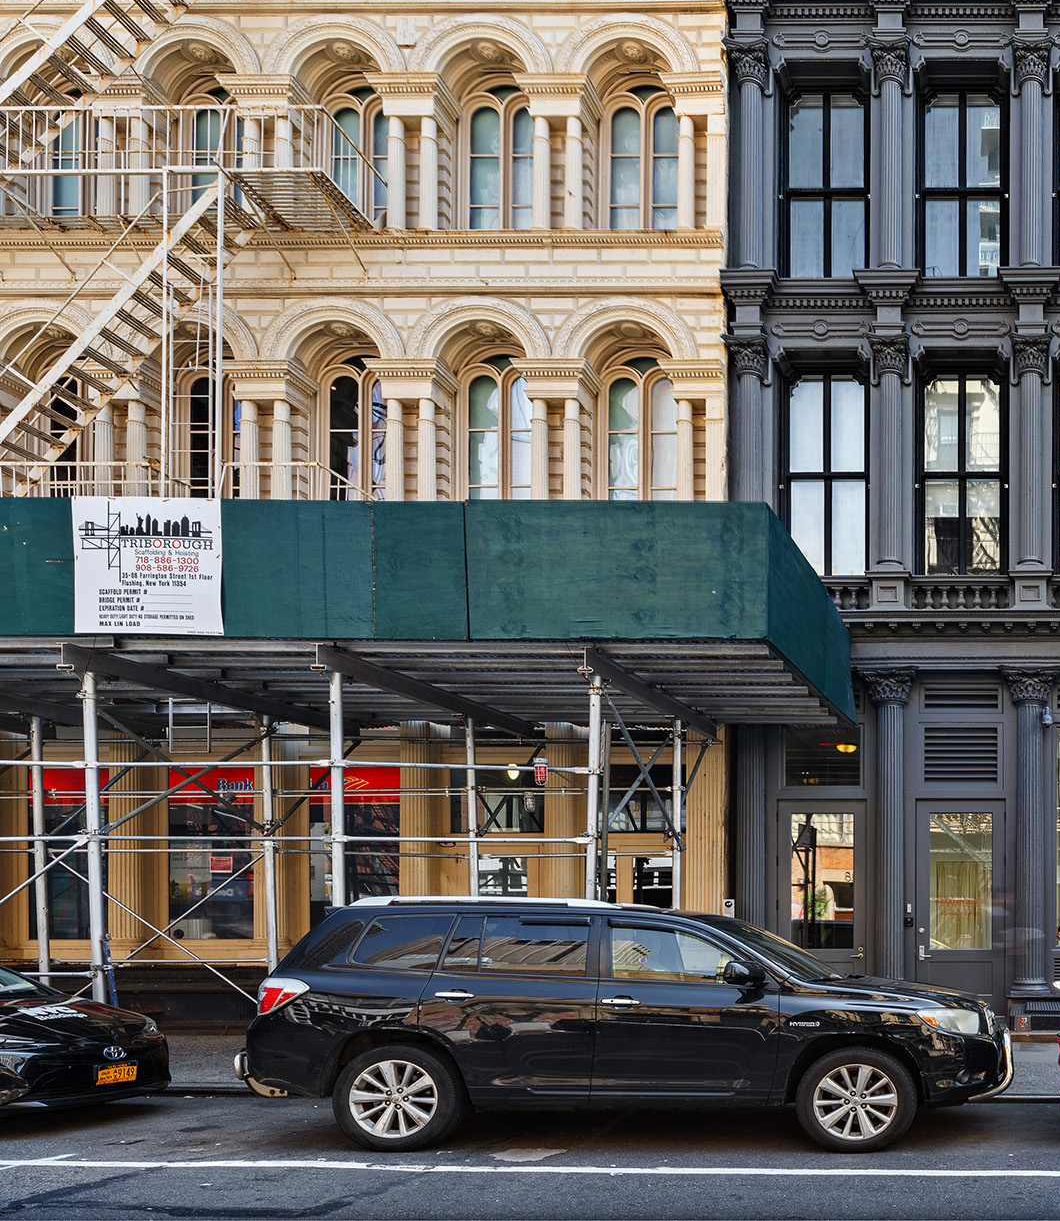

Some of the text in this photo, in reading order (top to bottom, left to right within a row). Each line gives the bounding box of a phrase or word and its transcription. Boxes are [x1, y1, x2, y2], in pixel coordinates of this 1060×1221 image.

[121, 539, 213, 550] TRIBOROUGH
[135, 556, 199, 565] 718-886-1300
[135, 564, 199, 572] 908-586-9726
[217, 778, 254, 791] Bank
